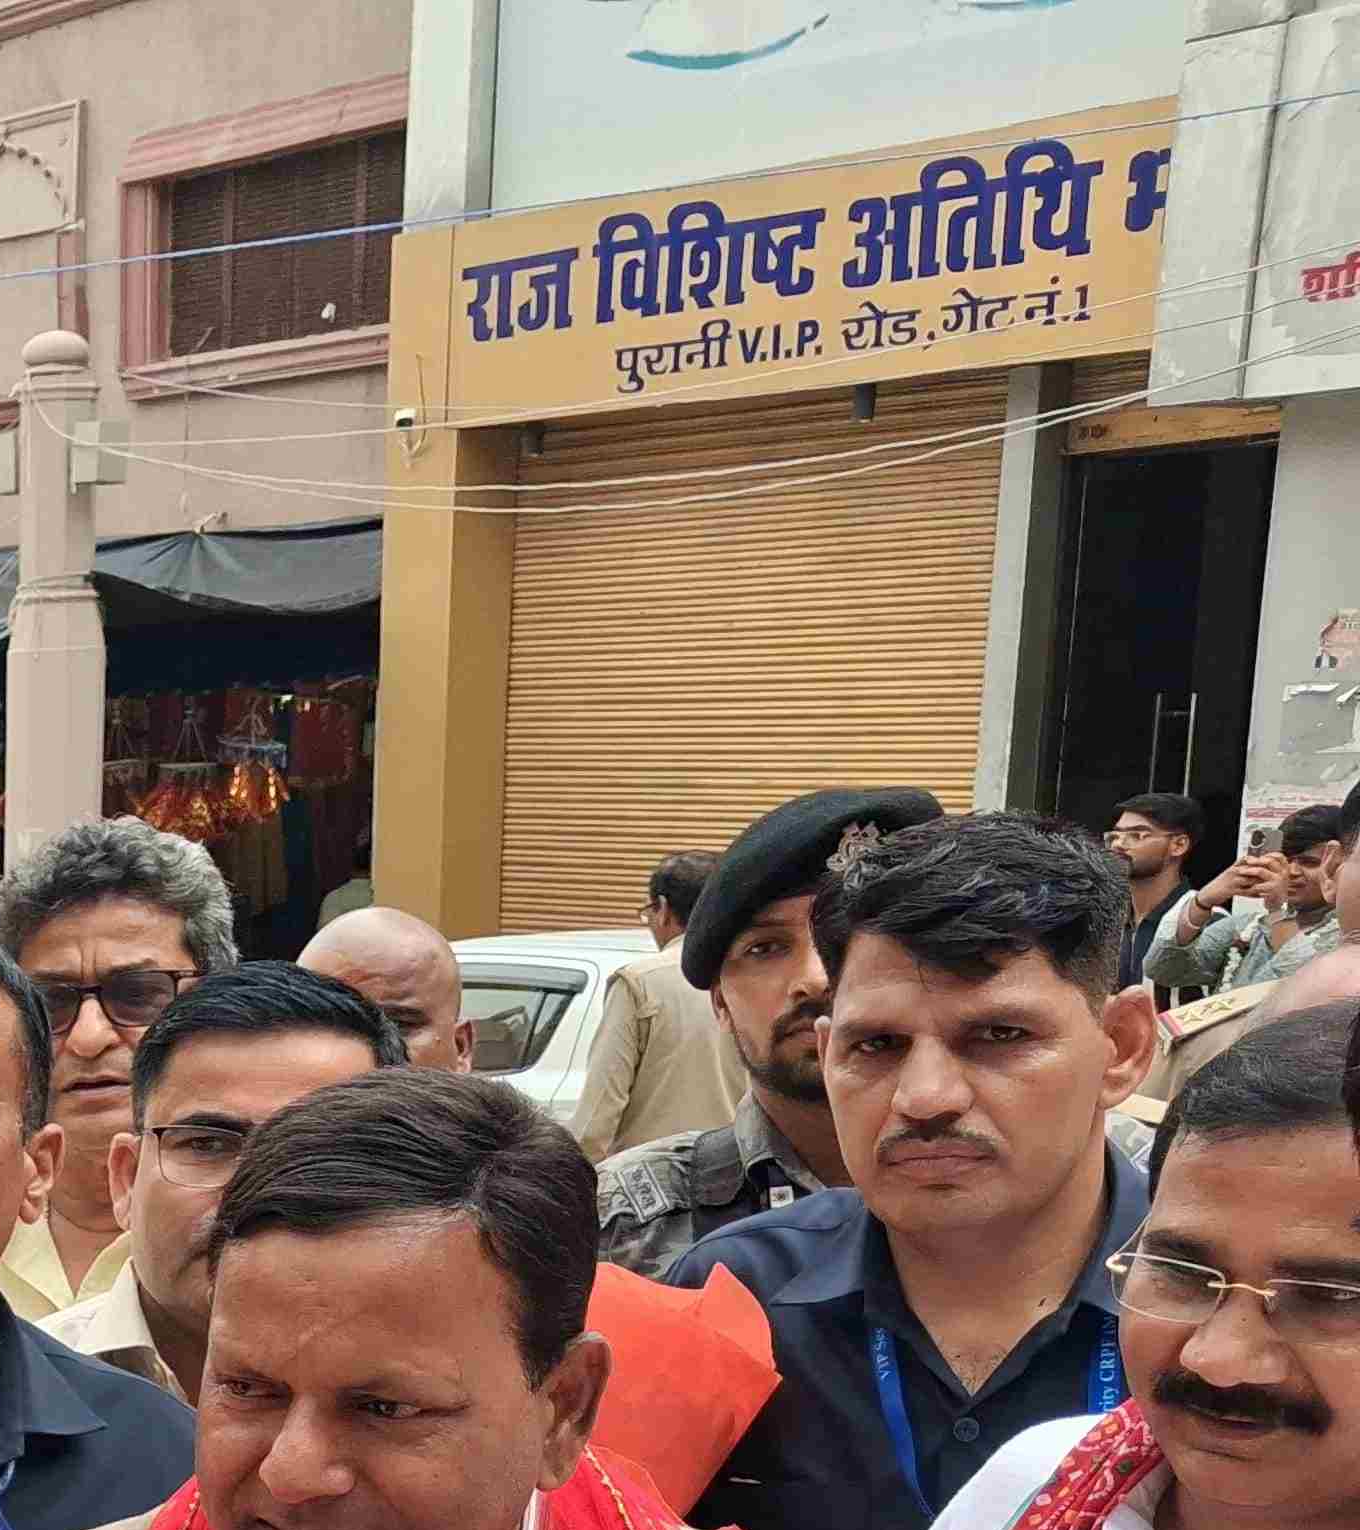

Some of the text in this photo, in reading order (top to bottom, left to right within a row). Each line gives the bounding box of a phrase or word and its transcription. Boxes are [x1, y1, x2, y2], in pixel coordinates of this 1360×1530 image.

[462, 247, 579, 342] राज
[592, 200, 826, 324] विशिष्ट
[842, 138, 1105, 288] अतिथि
[615, 319, 732, 394] पुरानी
[738, 319, 824, 364] V.I.P.
